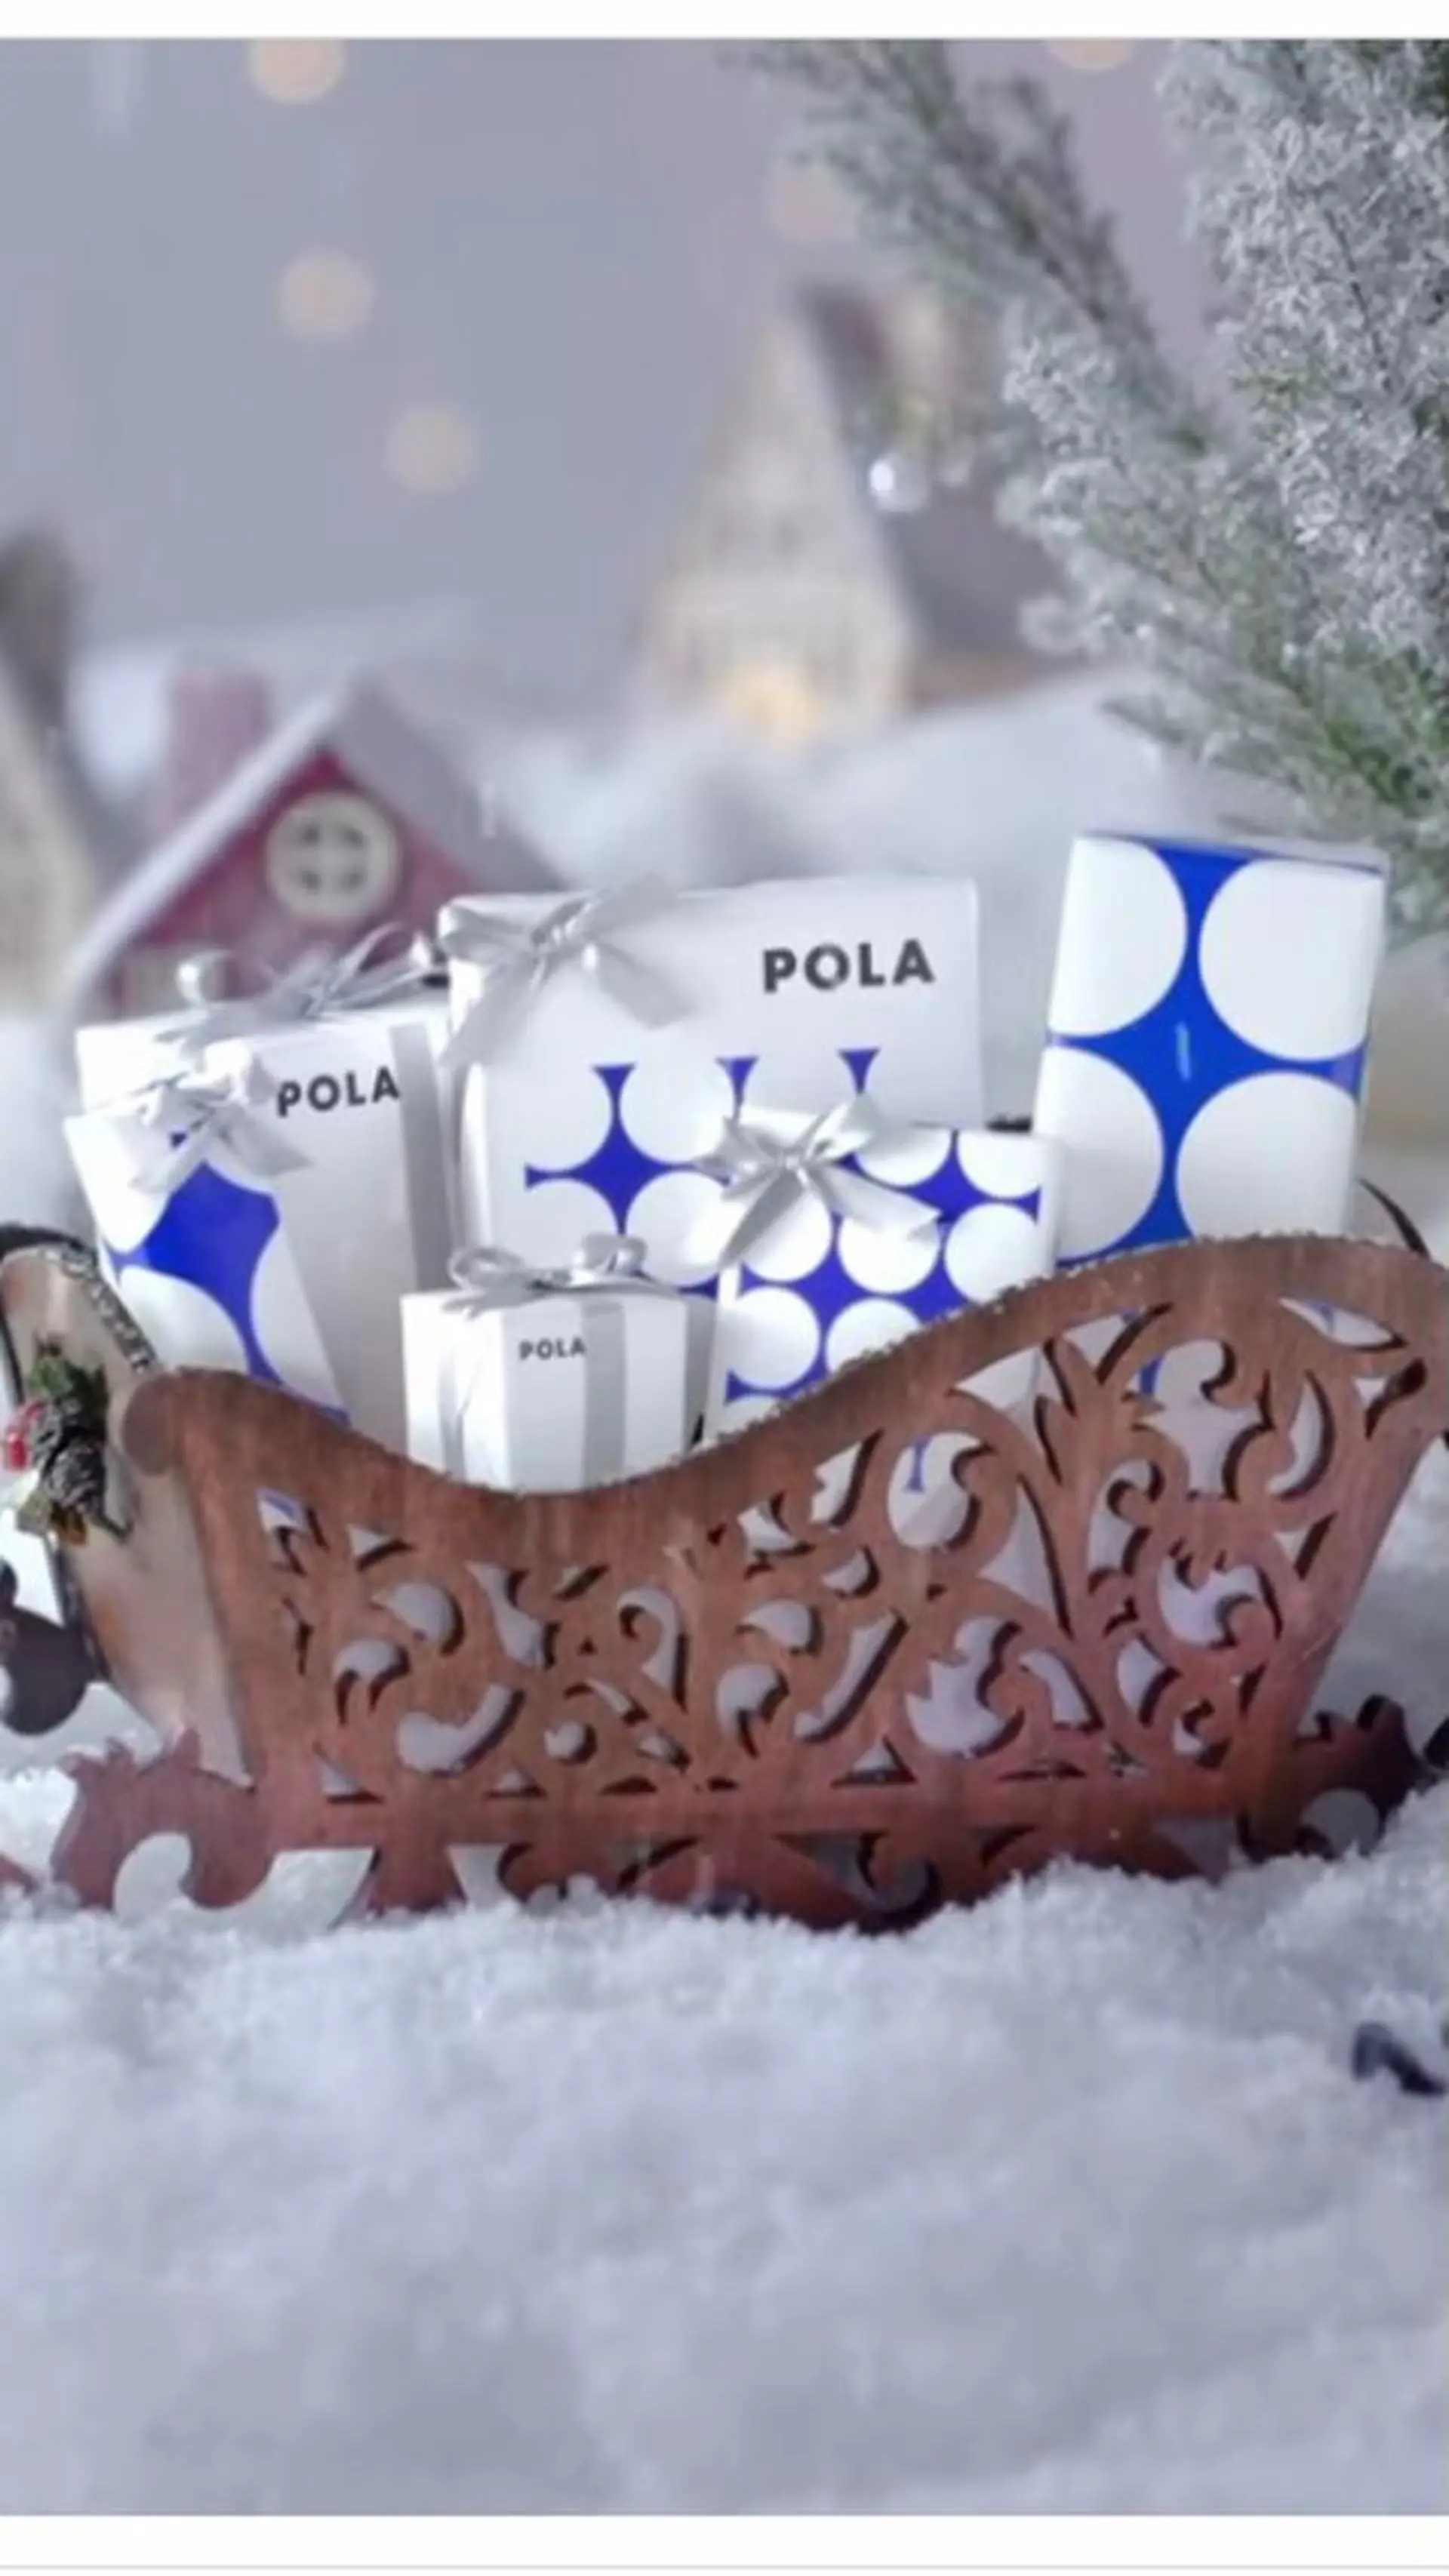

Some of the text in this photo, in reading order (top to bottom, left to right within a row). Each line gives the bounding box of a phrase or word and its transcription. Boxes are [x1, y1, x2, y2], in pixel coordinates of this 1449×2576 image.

[762, 938, 935, 993] POLA
[275, 1066, 401, 1118] POLA
[518, 1337, 587, 1361] POLA
